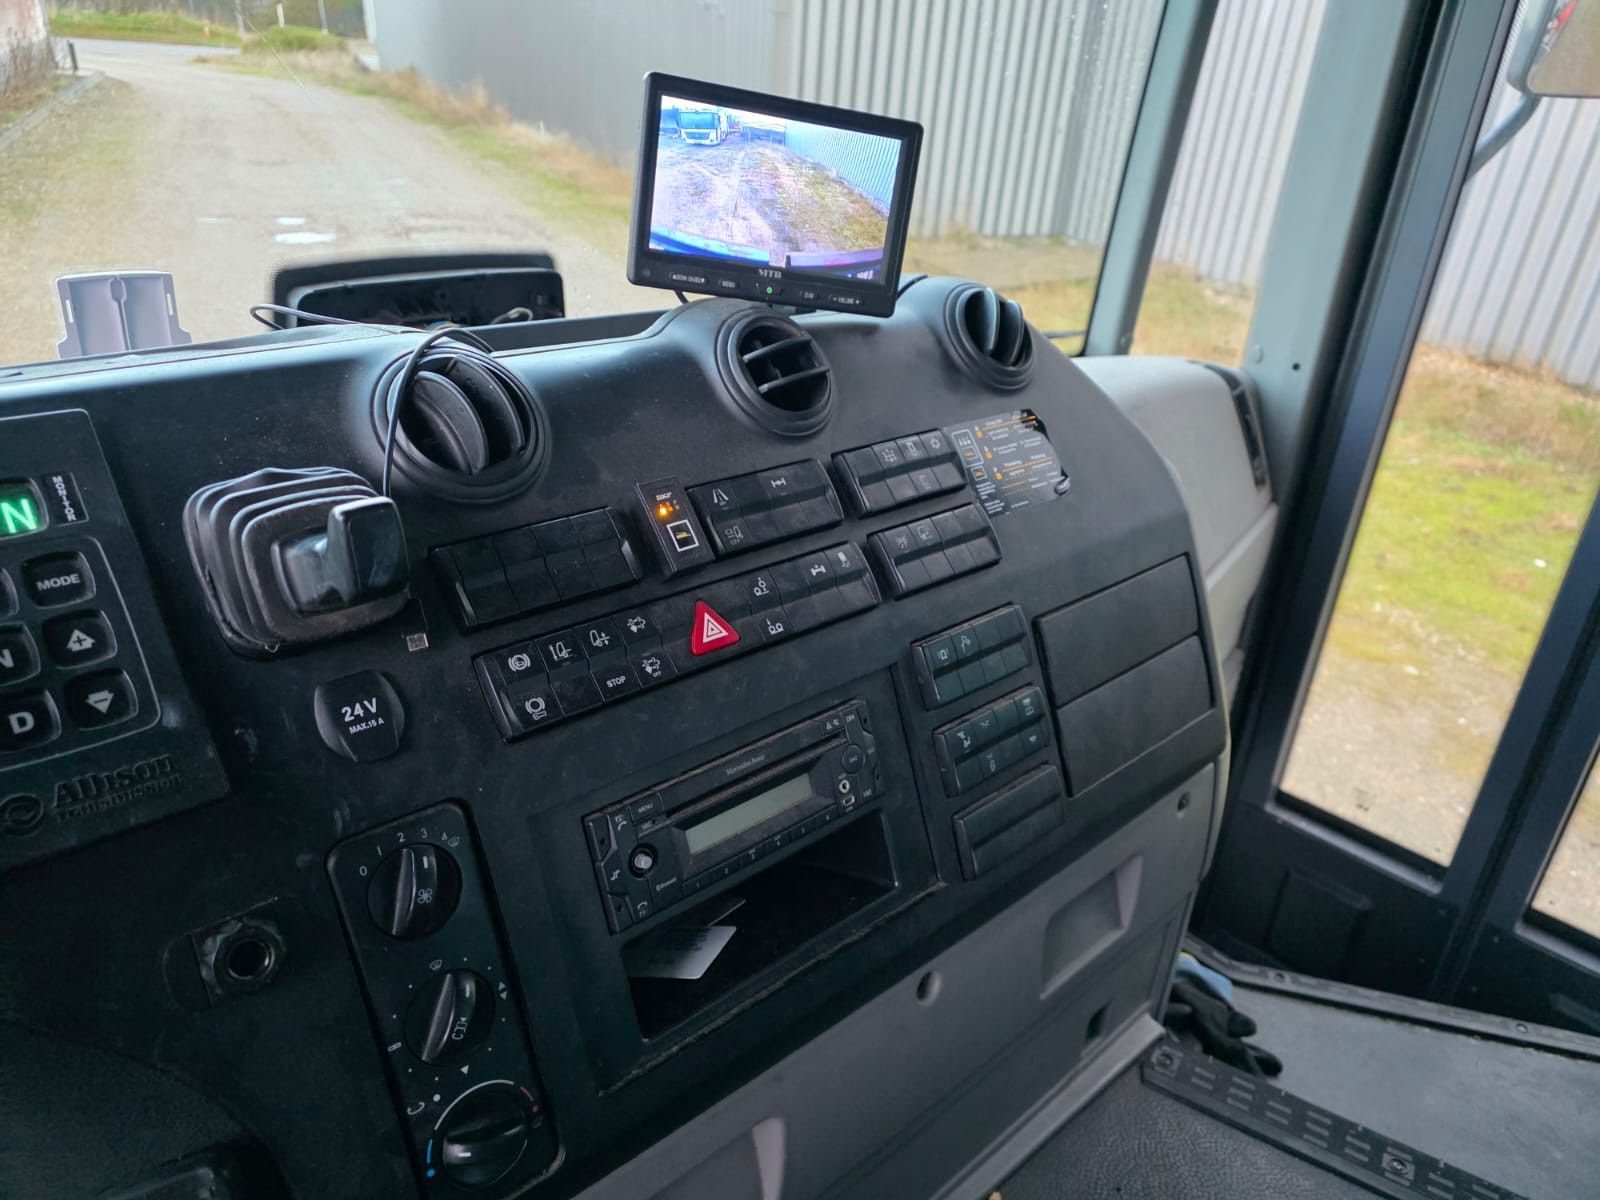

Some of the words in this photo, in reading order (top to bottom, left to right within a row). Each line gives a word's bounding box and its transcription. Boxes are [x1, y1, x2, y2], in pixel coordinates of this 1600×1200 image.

[52, 475, 77, 522] MONITOR
[1, 498, 37, 533] N
[36, 573, 80, 591] MODE
[606, 675, 626, 688] STOP
[341, 697, 377, 723] 24V
[8, 711, 35, 735] D
[397, 832, 405, 842] 2
[420, 828, 428, 838] 3
